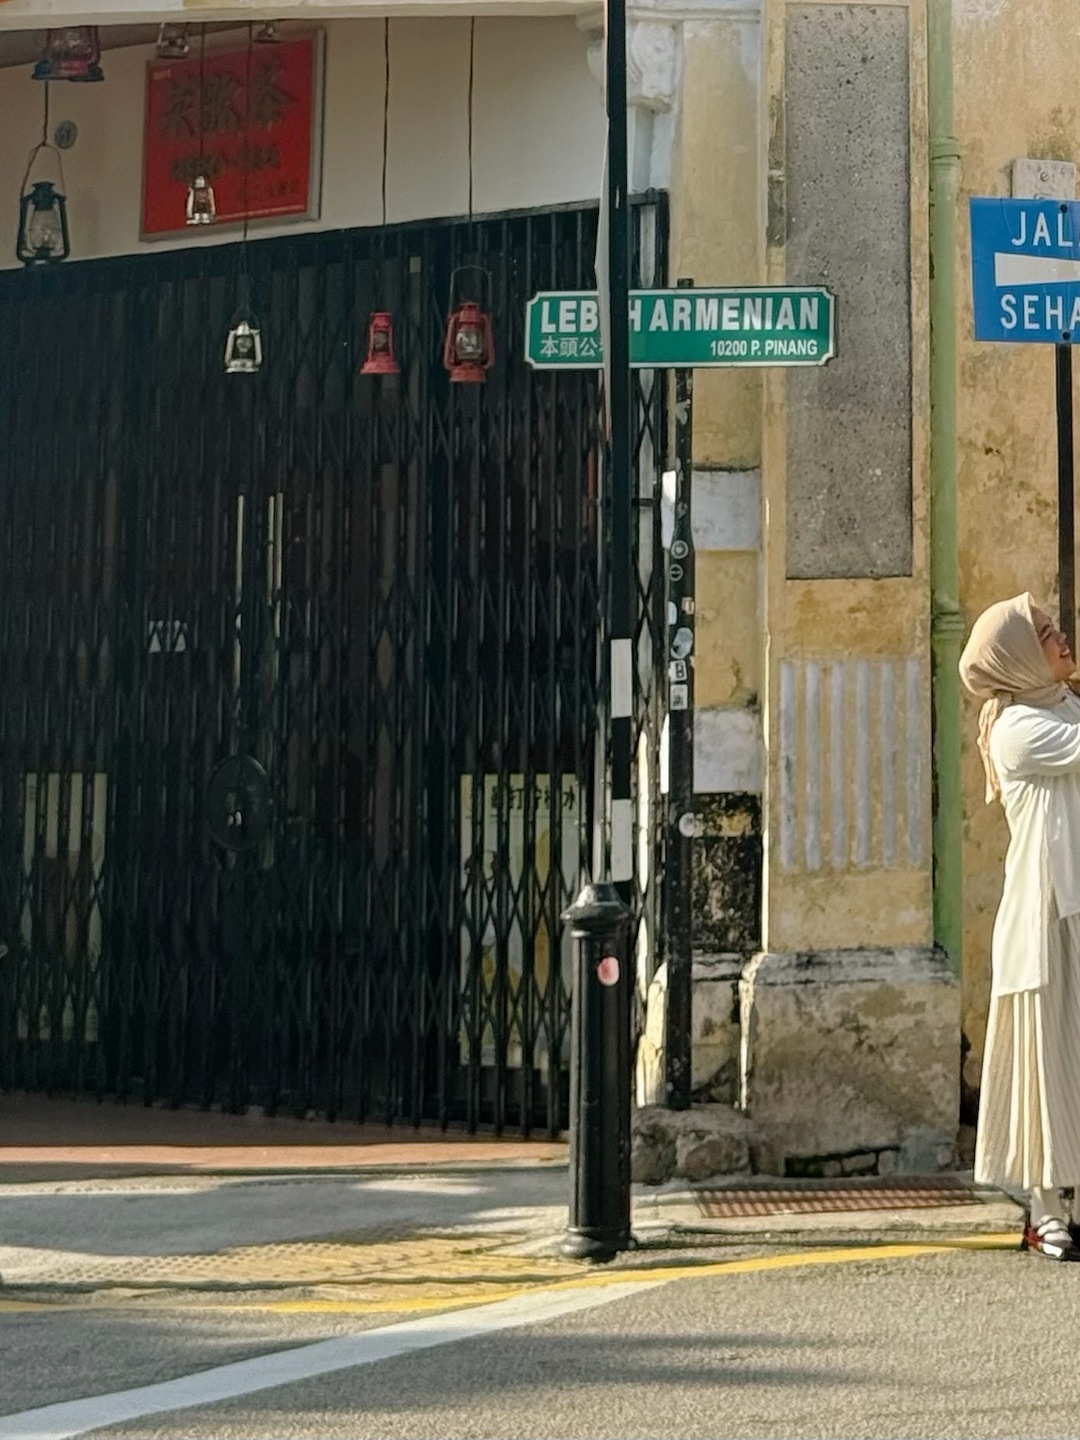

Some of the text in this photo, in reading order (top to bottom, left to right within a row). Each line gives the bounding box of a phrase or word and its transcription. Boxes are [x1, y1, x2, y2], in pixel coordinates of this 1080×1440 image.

[540, 297, 819, 333] LEBH ARMENIAN
[539, 336, 604, 358] 本頭公
[709, 339, 818, 356] 10200 P. PINANG
